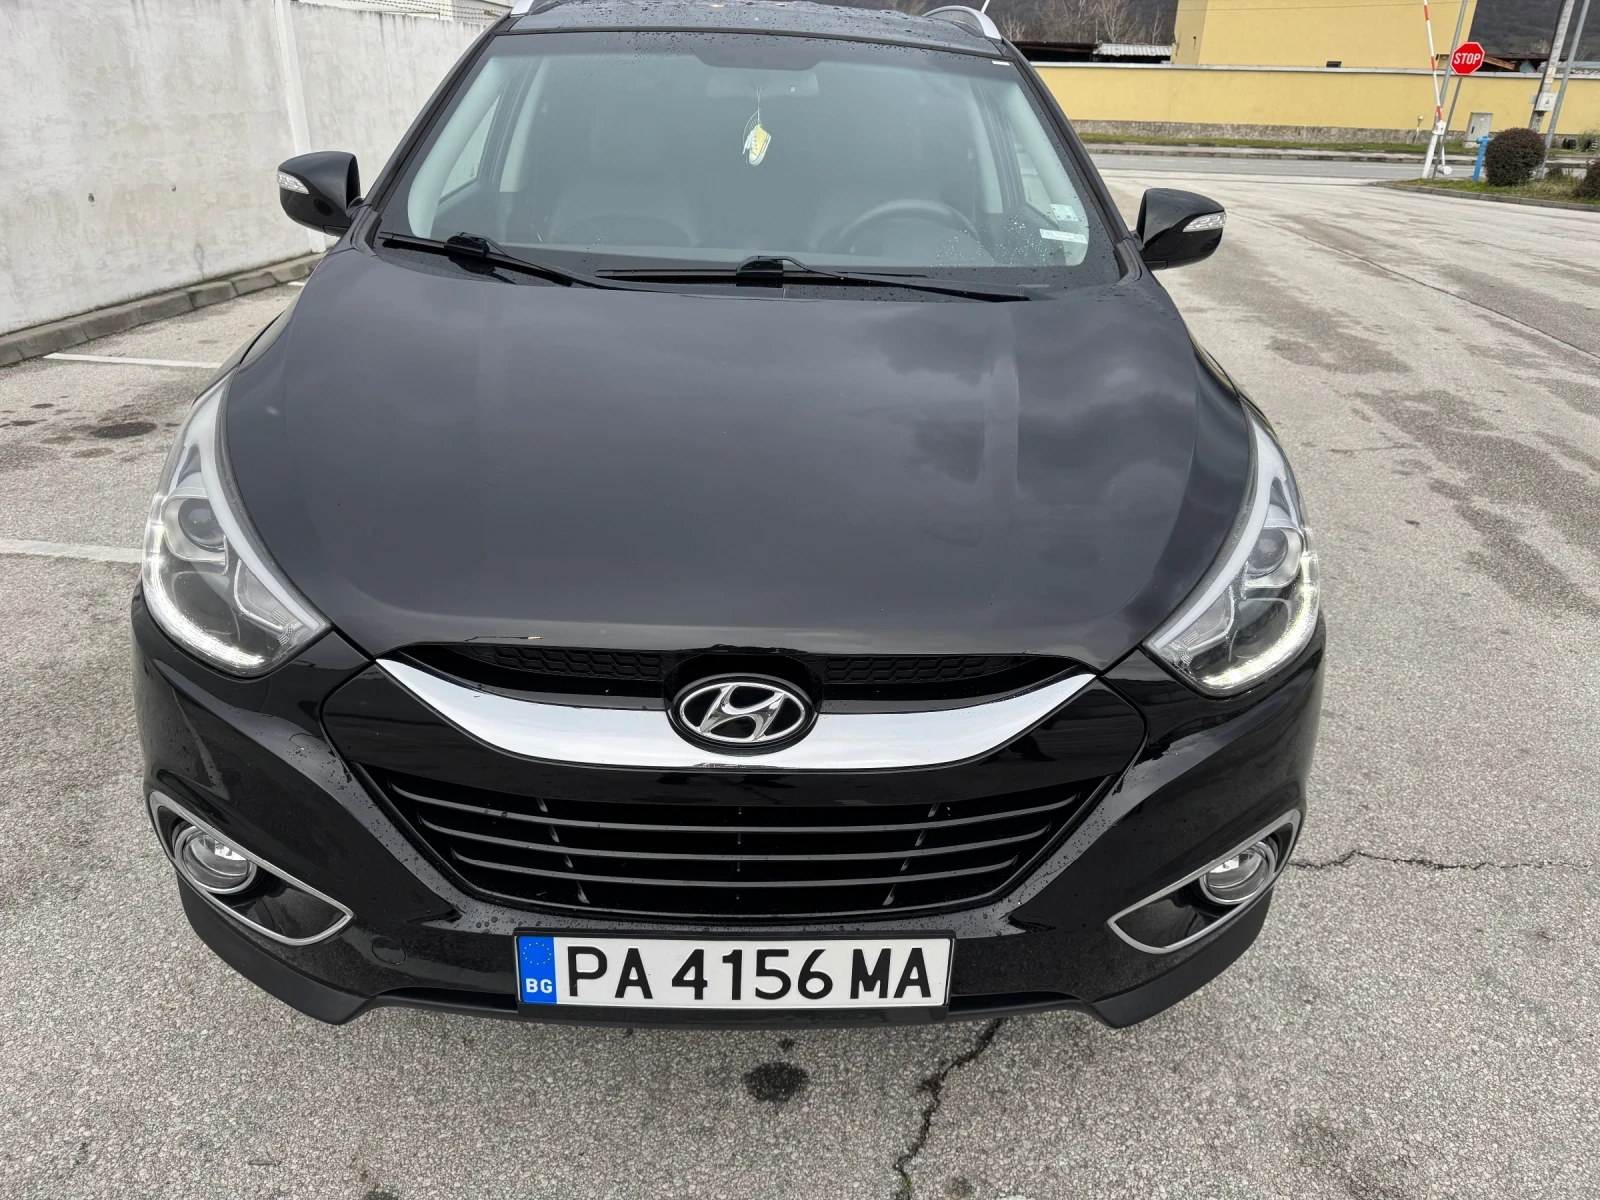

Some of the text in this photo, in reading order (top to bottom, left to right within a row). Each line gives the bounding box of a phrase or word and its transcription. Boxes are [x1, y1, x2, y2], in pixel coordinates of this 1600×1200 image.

[1453, 52, 1481, 65] STOP
[567, 946, 932, 1001] PA 4156 MA
[525, 978, 553, 993] BG
